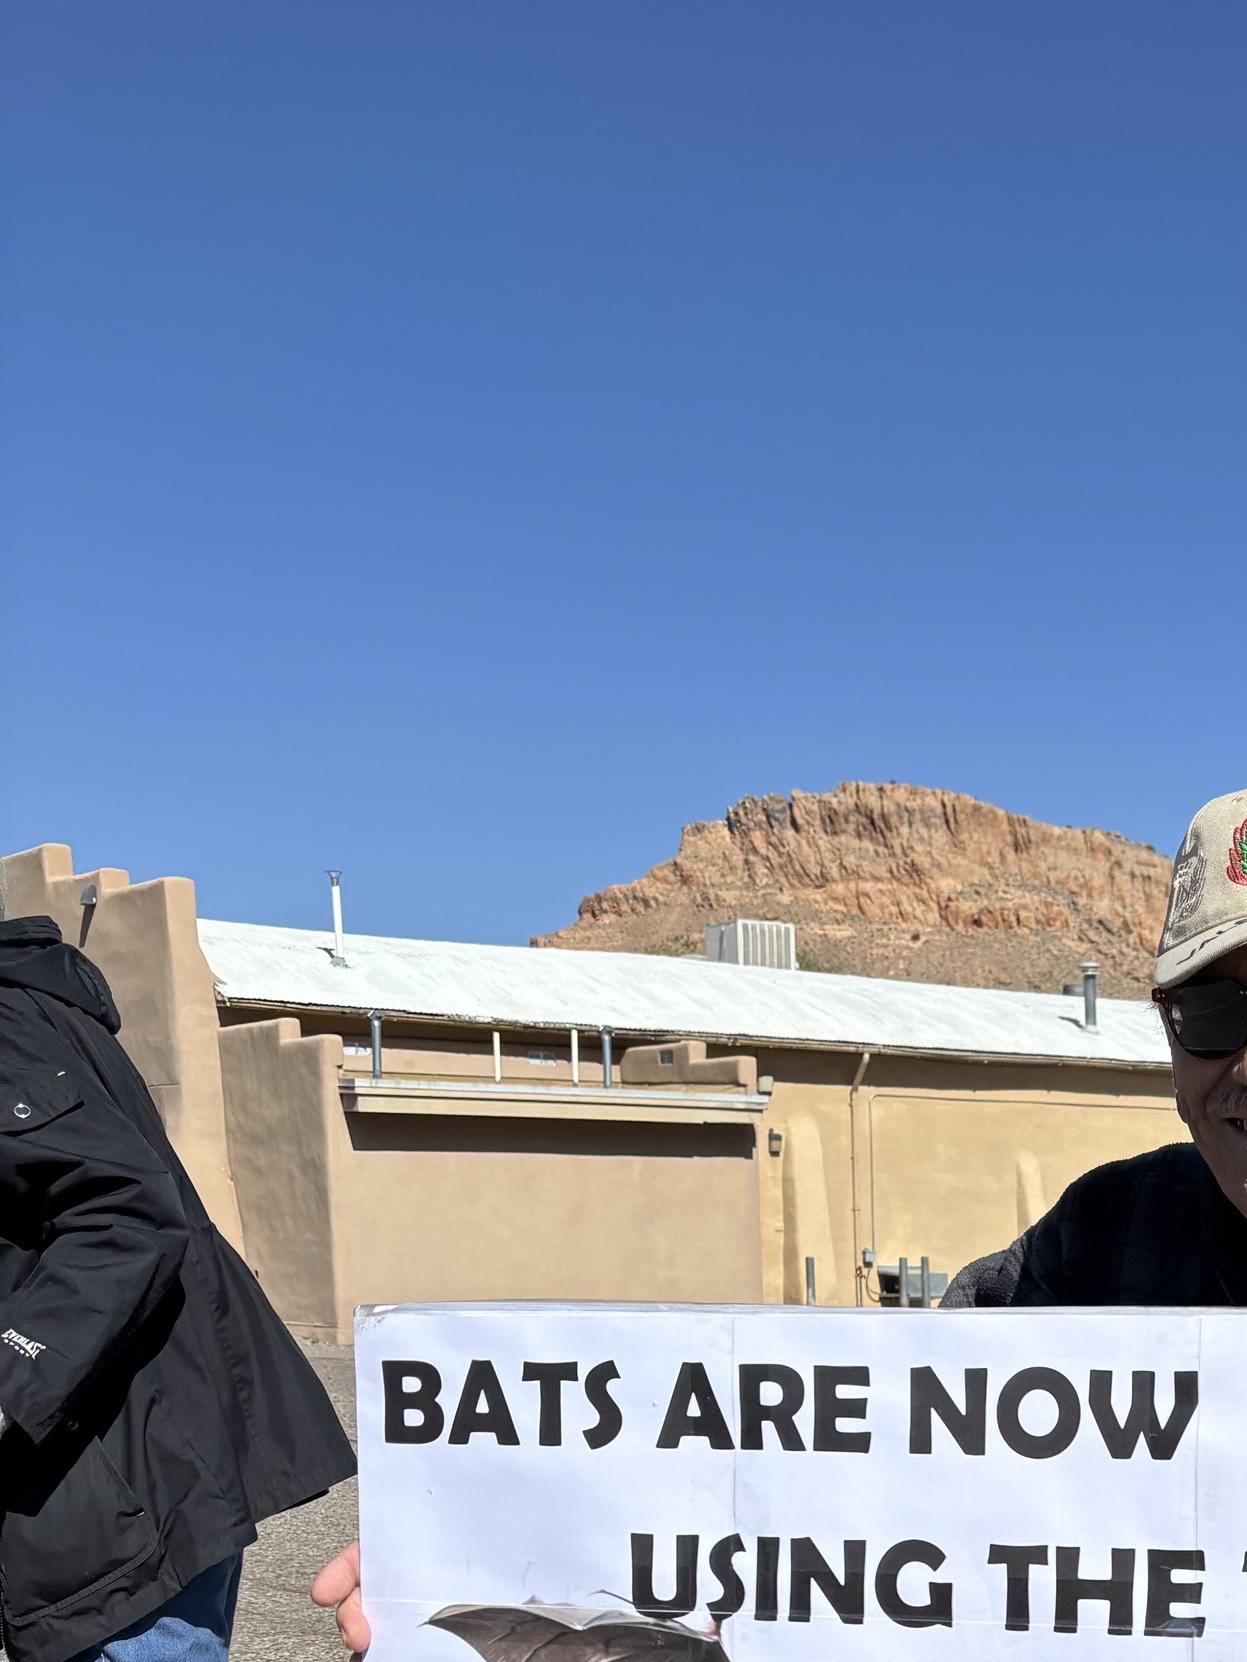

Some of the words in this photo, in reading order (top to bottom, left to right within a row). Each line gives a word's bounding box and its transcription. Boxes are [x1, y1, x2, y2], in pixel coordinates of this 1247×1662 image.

[381, 1359, 623, 1450] BATS
[656, 1362, 872, 1454] ARE
[909, 1366, 1199, 1461] NOW
[630, 1532, 954, 1629] USING
[988, 1544, 1206, 1638] THE
